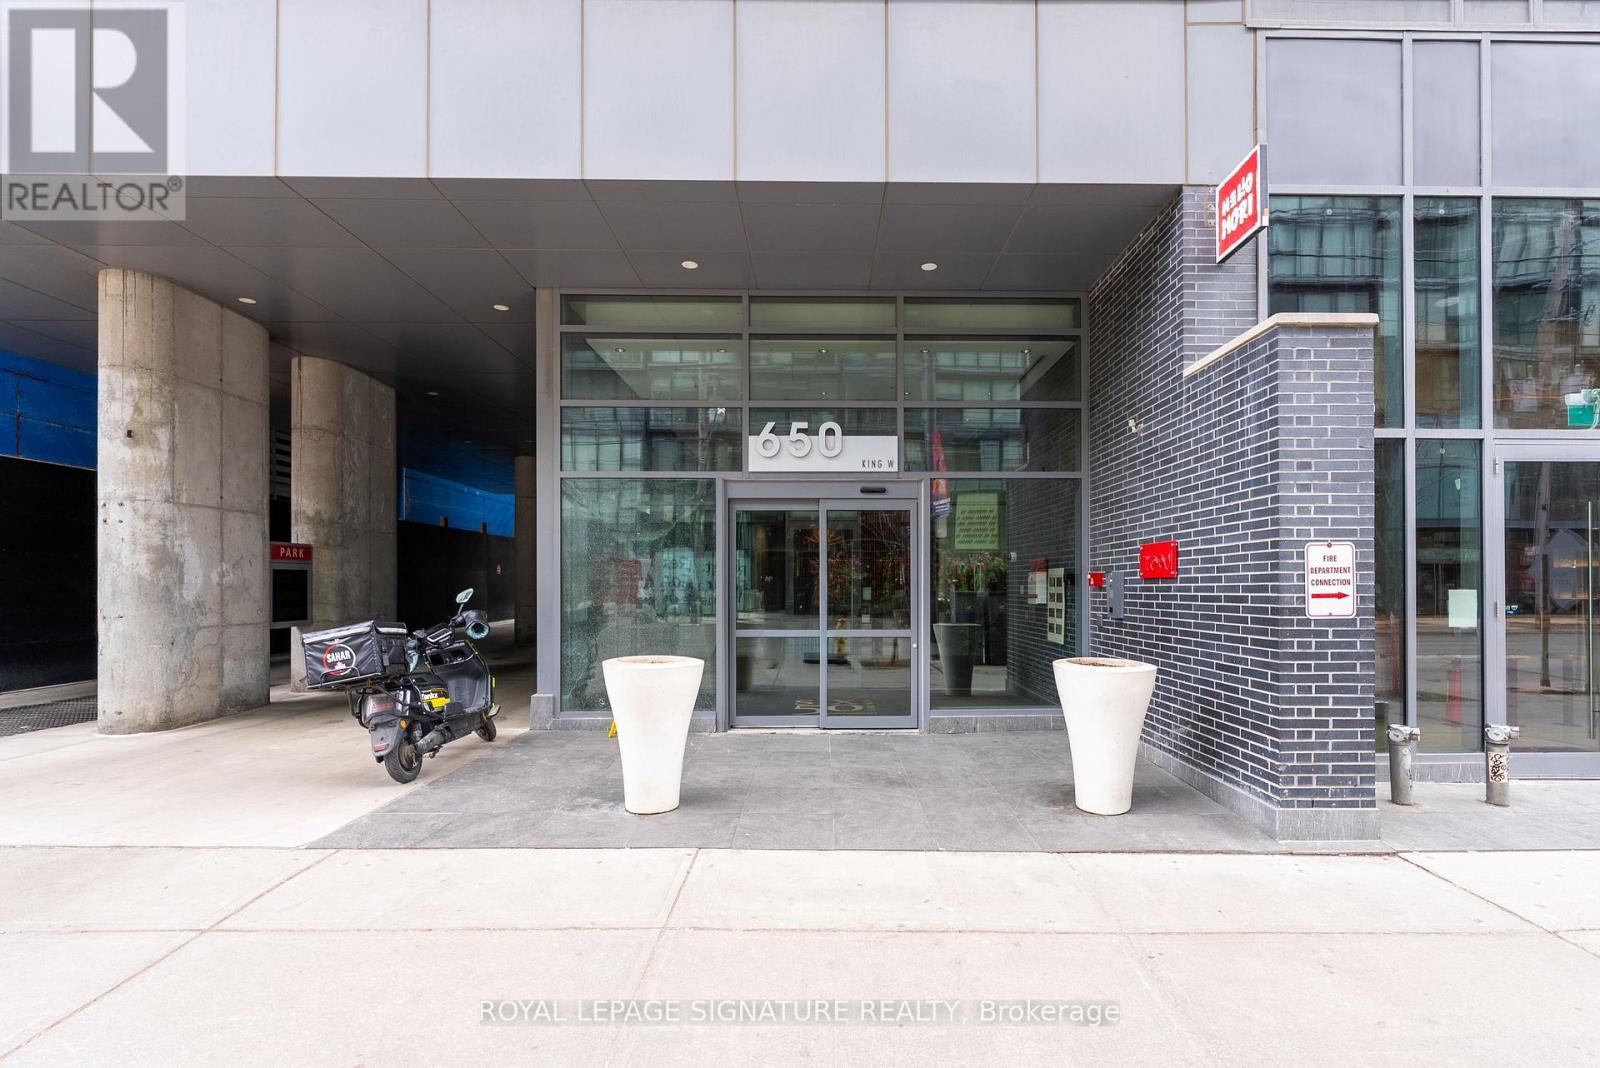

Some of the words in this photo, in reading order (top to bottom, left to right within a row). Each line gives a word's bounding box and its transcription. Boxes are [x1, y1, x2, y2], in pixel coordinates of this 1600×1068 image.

[757, 421, 843, 458] 650
[862, 459, 883, 469] KING
[888, 459, 895, 469] W
[280, 547, 304, 558] PARK
[326, 650, 351, 663] SAHAR
